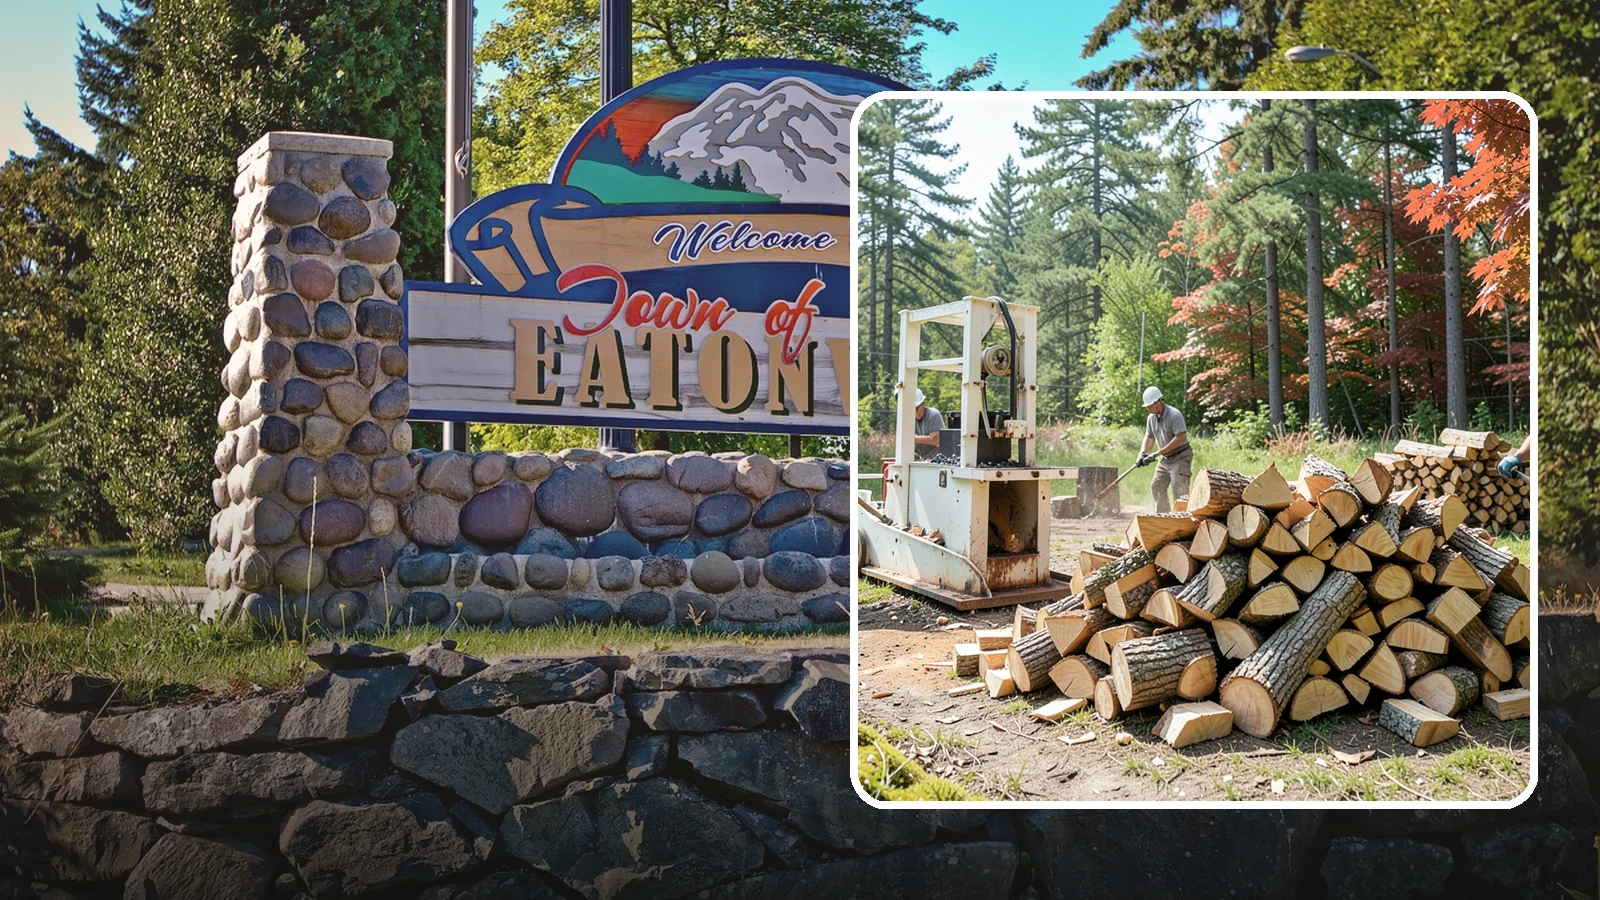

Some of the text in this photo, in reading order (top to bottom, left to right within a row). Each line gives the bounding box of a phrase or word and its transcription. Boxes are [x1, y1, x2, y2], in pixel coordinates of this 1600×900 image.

[653, 220, 837, 263] Welcome
[557, 263, 826, 365] Town of
